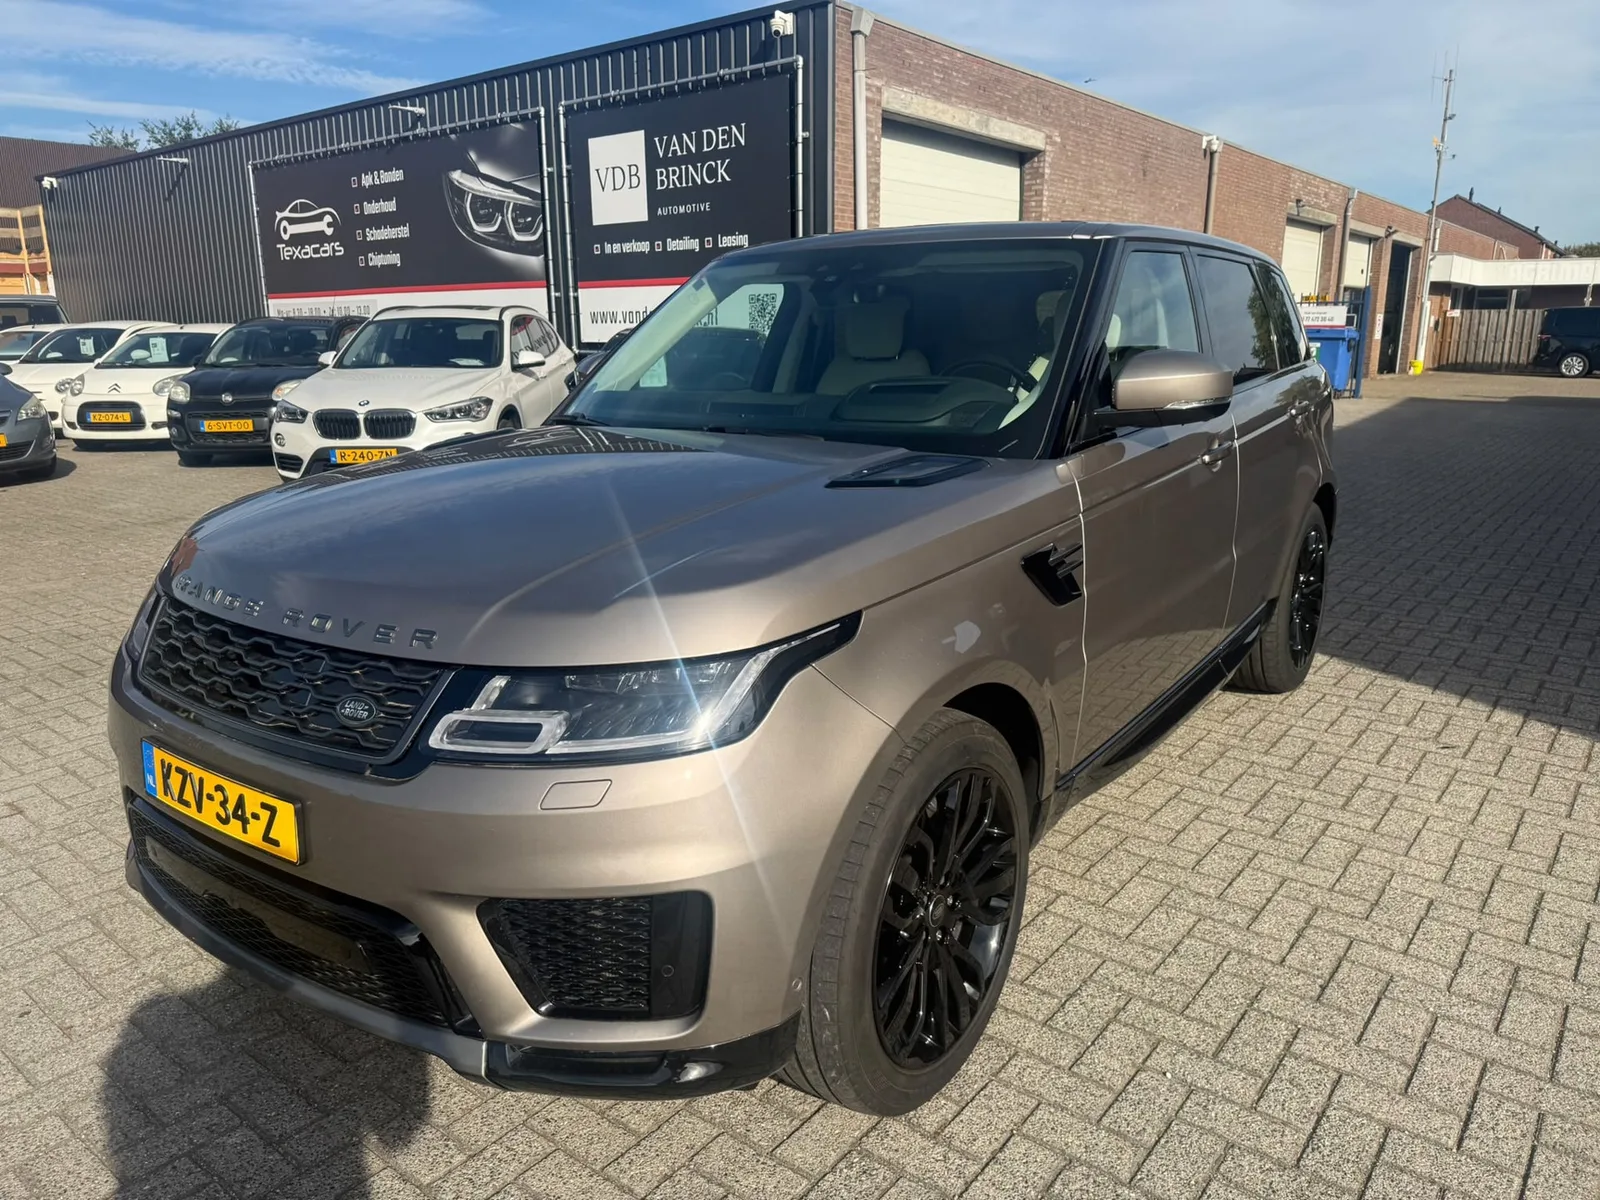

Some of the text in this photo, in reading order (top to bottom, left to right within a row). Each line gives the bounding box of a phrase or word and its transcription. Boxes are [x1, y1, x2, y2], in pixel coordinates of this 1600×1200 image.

[654, 123, 746, 158] VAN DEN
[362, 171, 374, 189] Apk
[374, 171, 380, 184] &
[595, 164, 641, 192] VDB
[656, 159, 731, 190] BRINCK
[363, 196, 397, 215] Onderhoud
[657, 202, 711, 216] AUTOMOTIVE
[366, 222, 410, 241] Schadeherstel
[718, 232, 749, 249] Leasing
[604, 239, 650, 254] In en verkoop
[666, 236, 700, 252] Detailing
[368, 250, 401, 268] Chiptuning
[92, 413, 128, 422] KZ-074-L
[207, 421, 250, 431] 6-SVT-00
[282, 607, 440, 650] ROVER
[343, 708, 369, 719] ROVER
[344, 699, 365, 710] LAND
[160, 757, 281, 848] KZV-34-Z
